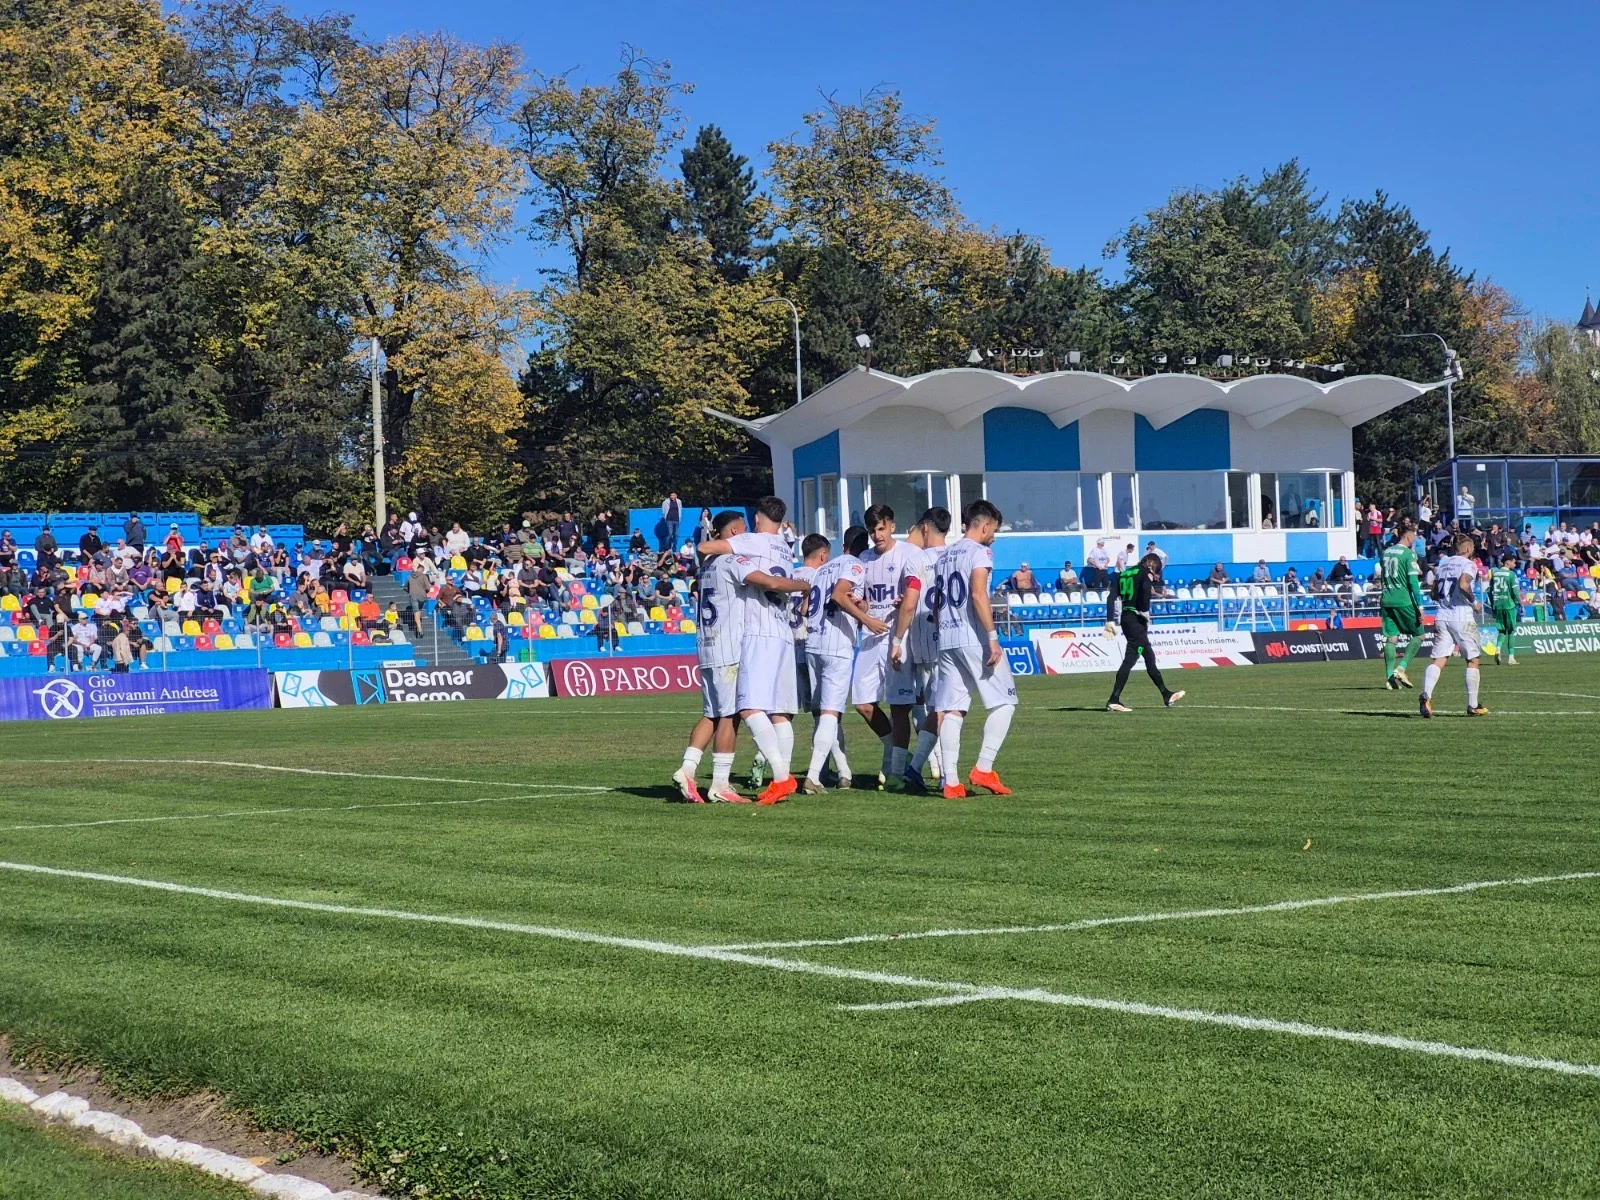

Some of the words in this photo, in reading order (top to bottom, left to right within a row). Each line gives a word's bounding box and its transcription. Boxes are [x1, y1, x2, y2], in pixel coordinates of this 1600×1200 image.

[868, 583, 895, 602] NTH
[1493, 577, 1508, 592] 24
[1265, 641, 1290, 657] NTH
[1062, 660, 1093, 668] MACOS
[88, 675, 115, 688] Gio
[385, 668, 474, 688] Dasmar
[599, 666, 670, 691] PARO
[90, 688, 156, 703] Giovanni
[160, 686, 218, 699] Andreea
[93, 707, 117, 717] hale
[119, 705, 166, 716] metalice
